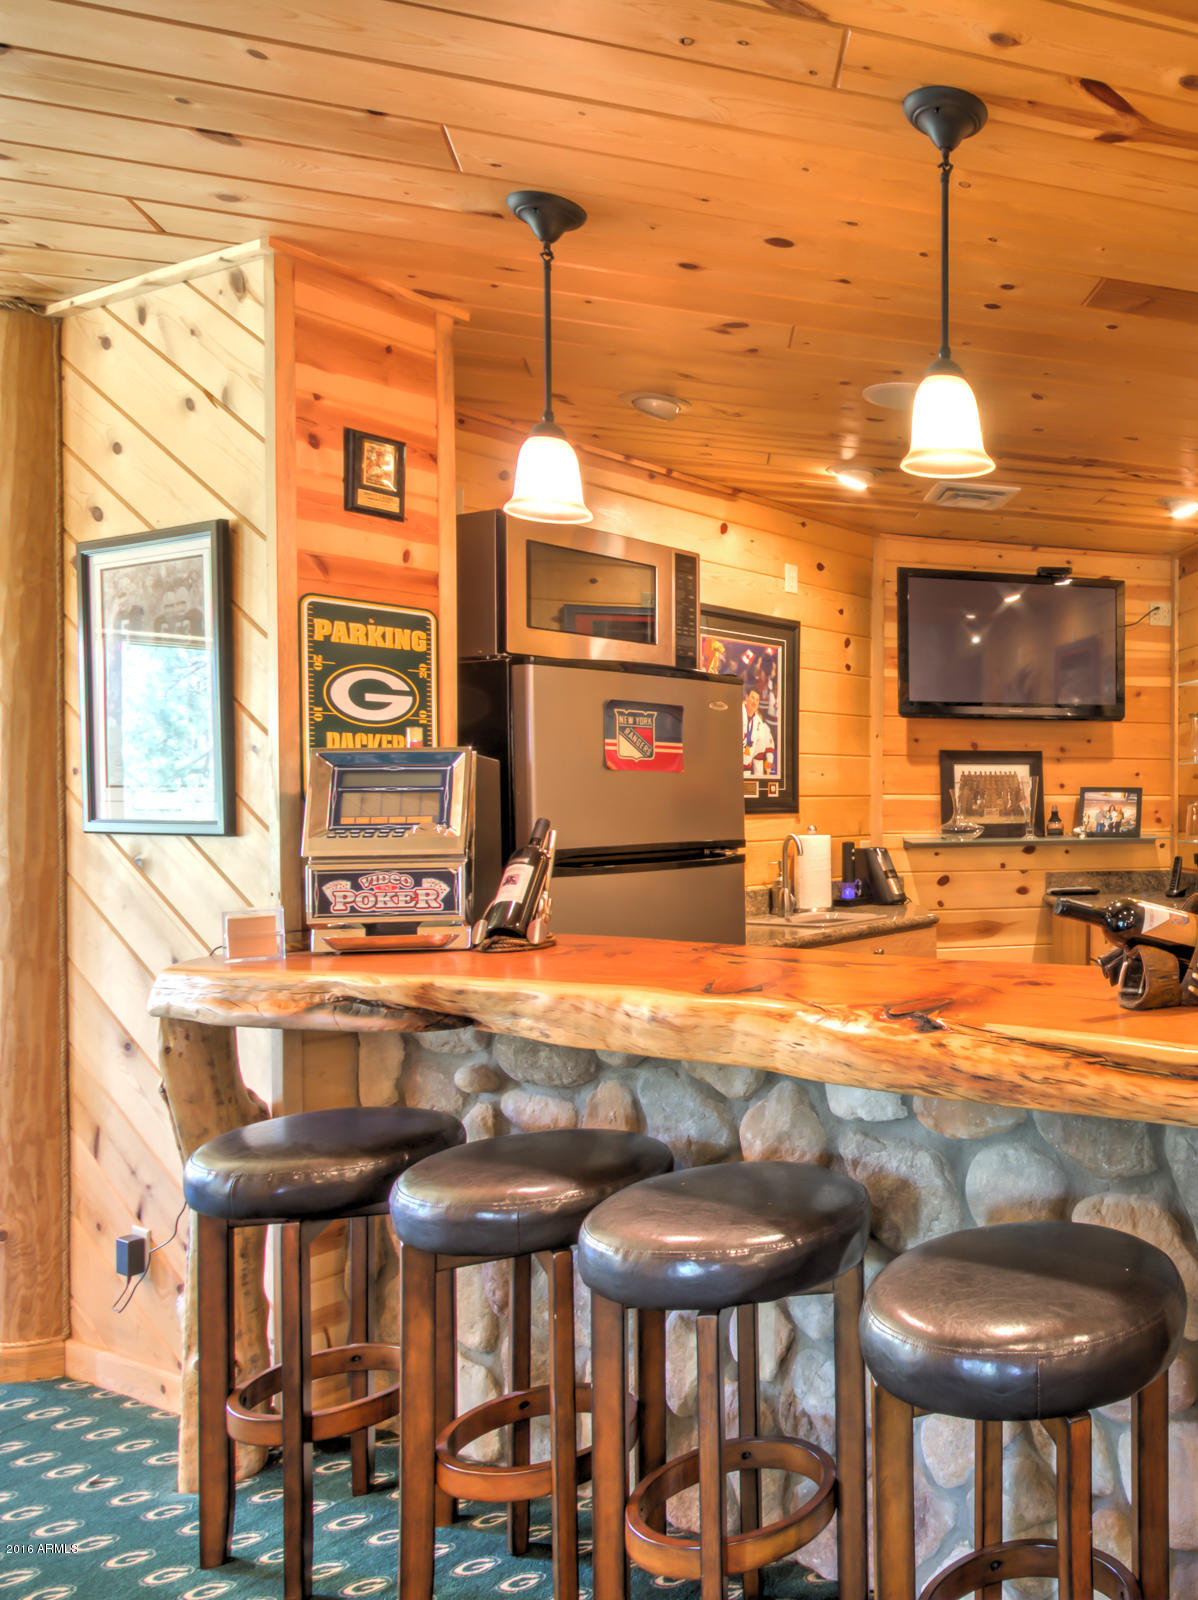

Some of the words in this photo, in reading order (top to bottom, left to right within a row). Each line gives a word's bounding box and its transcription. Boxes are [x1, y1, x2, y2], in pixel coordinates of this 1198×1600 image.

[313, 618, 428, 652] PARKING
[330, 669, 414, 721] G
[618, 715, 634, 725] NEW
[635, 716, 653, 726] YORK
[326, 731, 406, 748] PACKER
[623, 727, 651, 756] RANGERS
[359, 872, 414, 889] VIDEO
[331, 888, 443, 912] POKER
